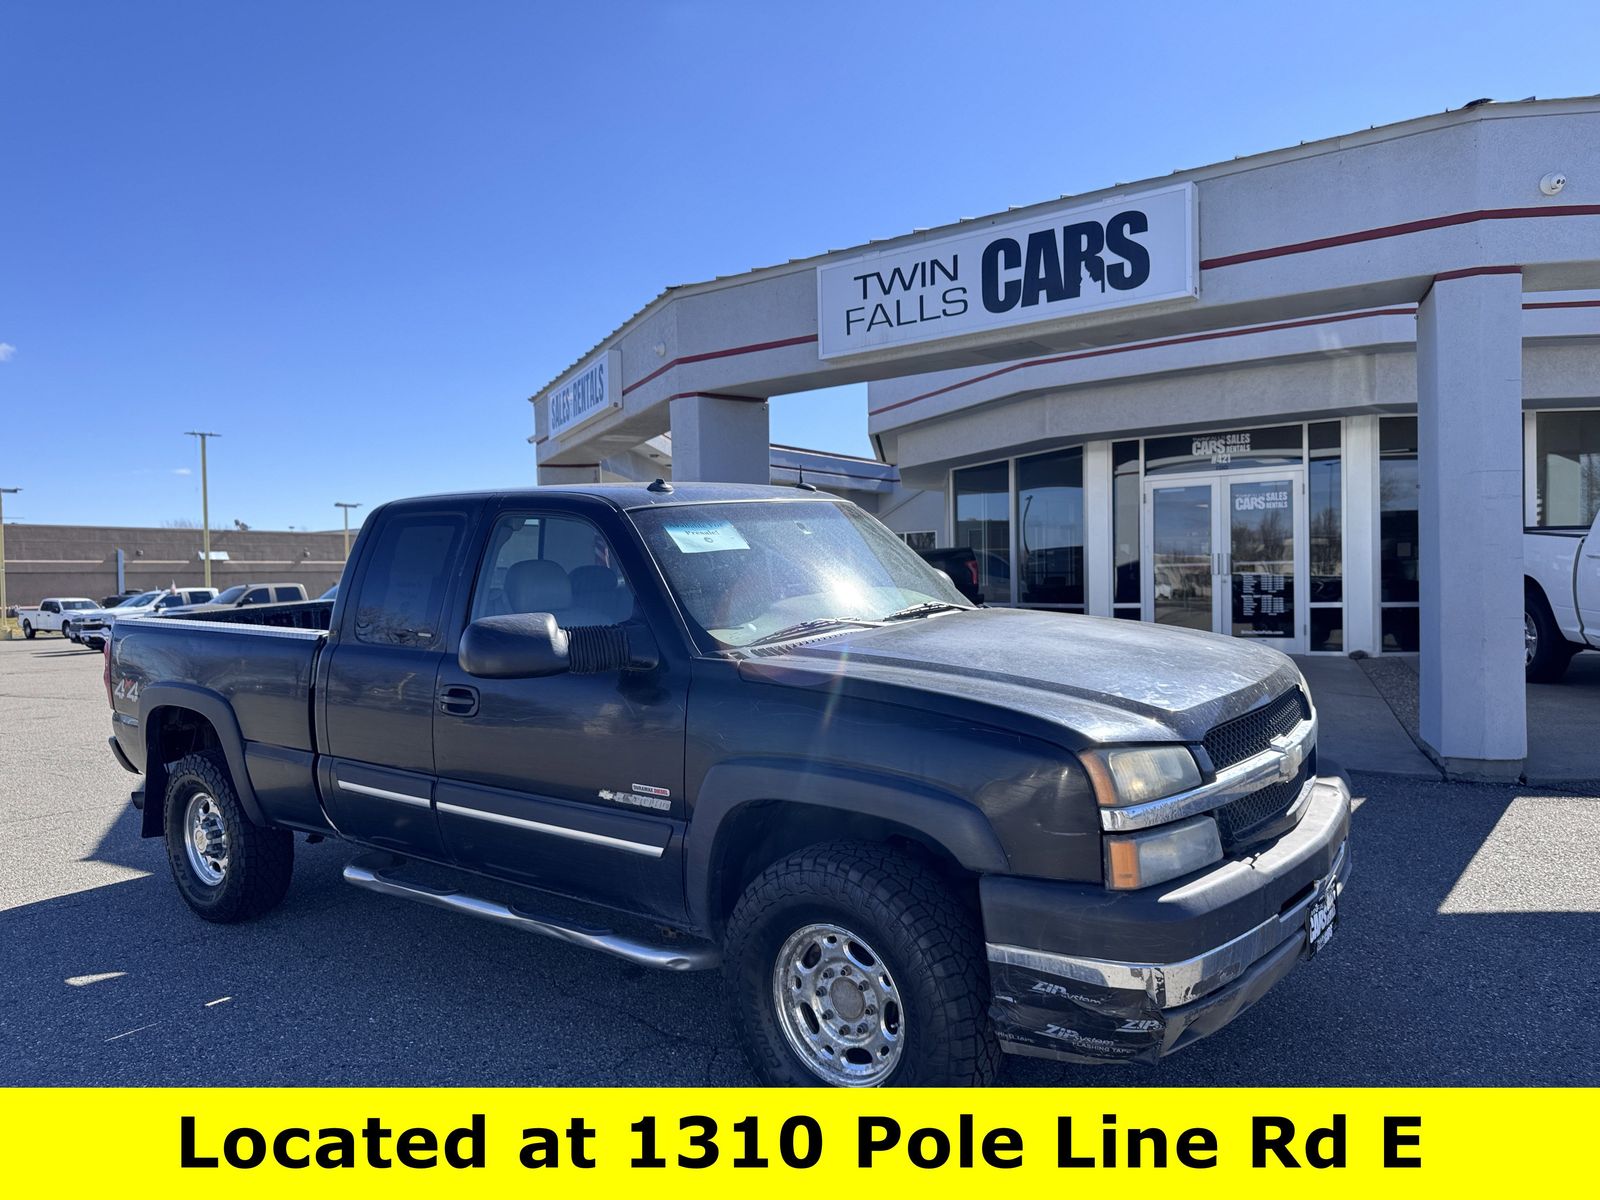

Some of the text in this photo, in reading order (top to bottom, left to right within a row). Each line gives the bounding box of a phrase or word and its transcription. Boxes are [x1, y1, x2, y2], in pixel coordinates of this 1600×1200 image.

[982, 210, 1149, 314] CARS
[854, 254, 958, 299] TWIN
[846, 286, 968, 336] FALLS
[551, 363, 604, 430] SALES RENTALS
[1226, 433, 1251, 444] SALES
[1192, 439, 1226, 456] CARS
[1211, 454, 1231, 464] #421
[1235, 497, 1265, 510] CARS
[1265, 491, 1288, 501] SALES
